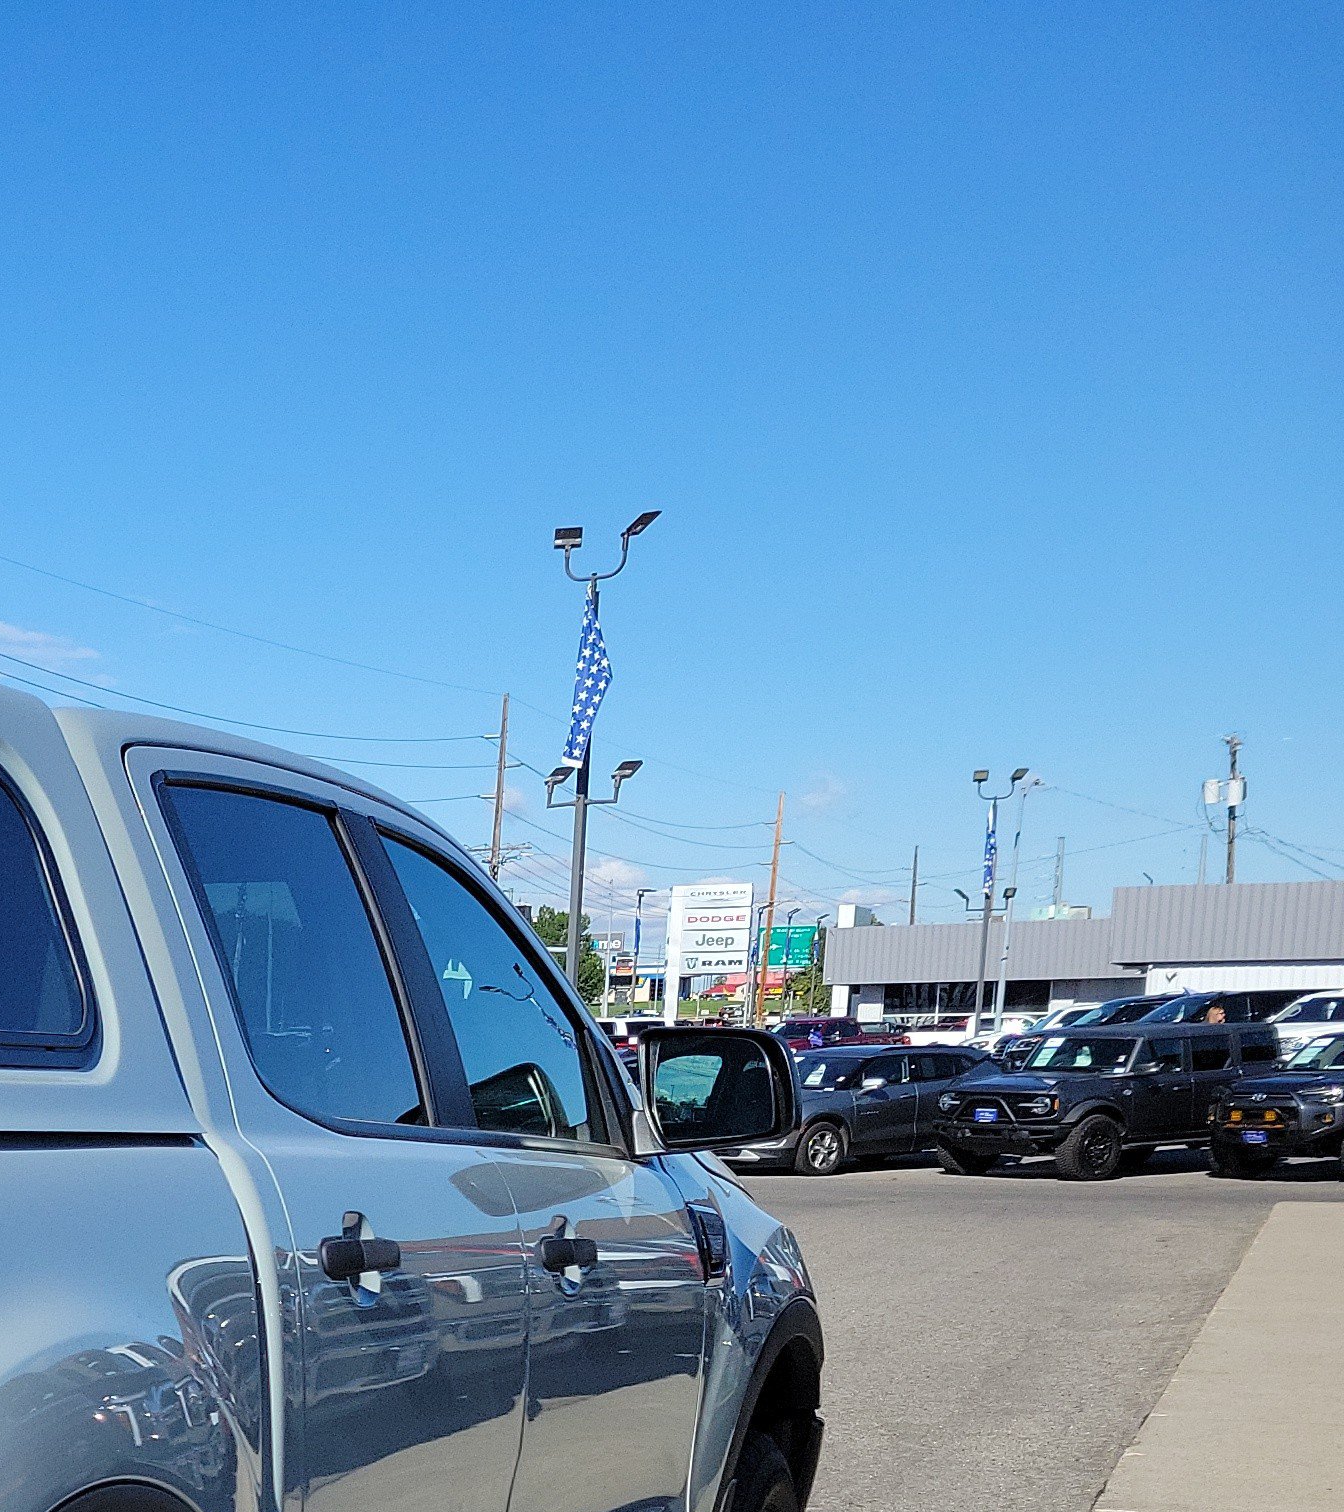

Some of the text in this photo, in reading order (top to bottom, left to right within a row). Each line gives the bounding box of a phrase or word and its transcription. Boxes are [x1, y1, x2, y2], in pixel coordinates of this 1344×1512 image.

[687, 915, 747, 923] DODGE
[695, 933, 735, 949] Jeep
[701, 959, 744, 967] RAM
